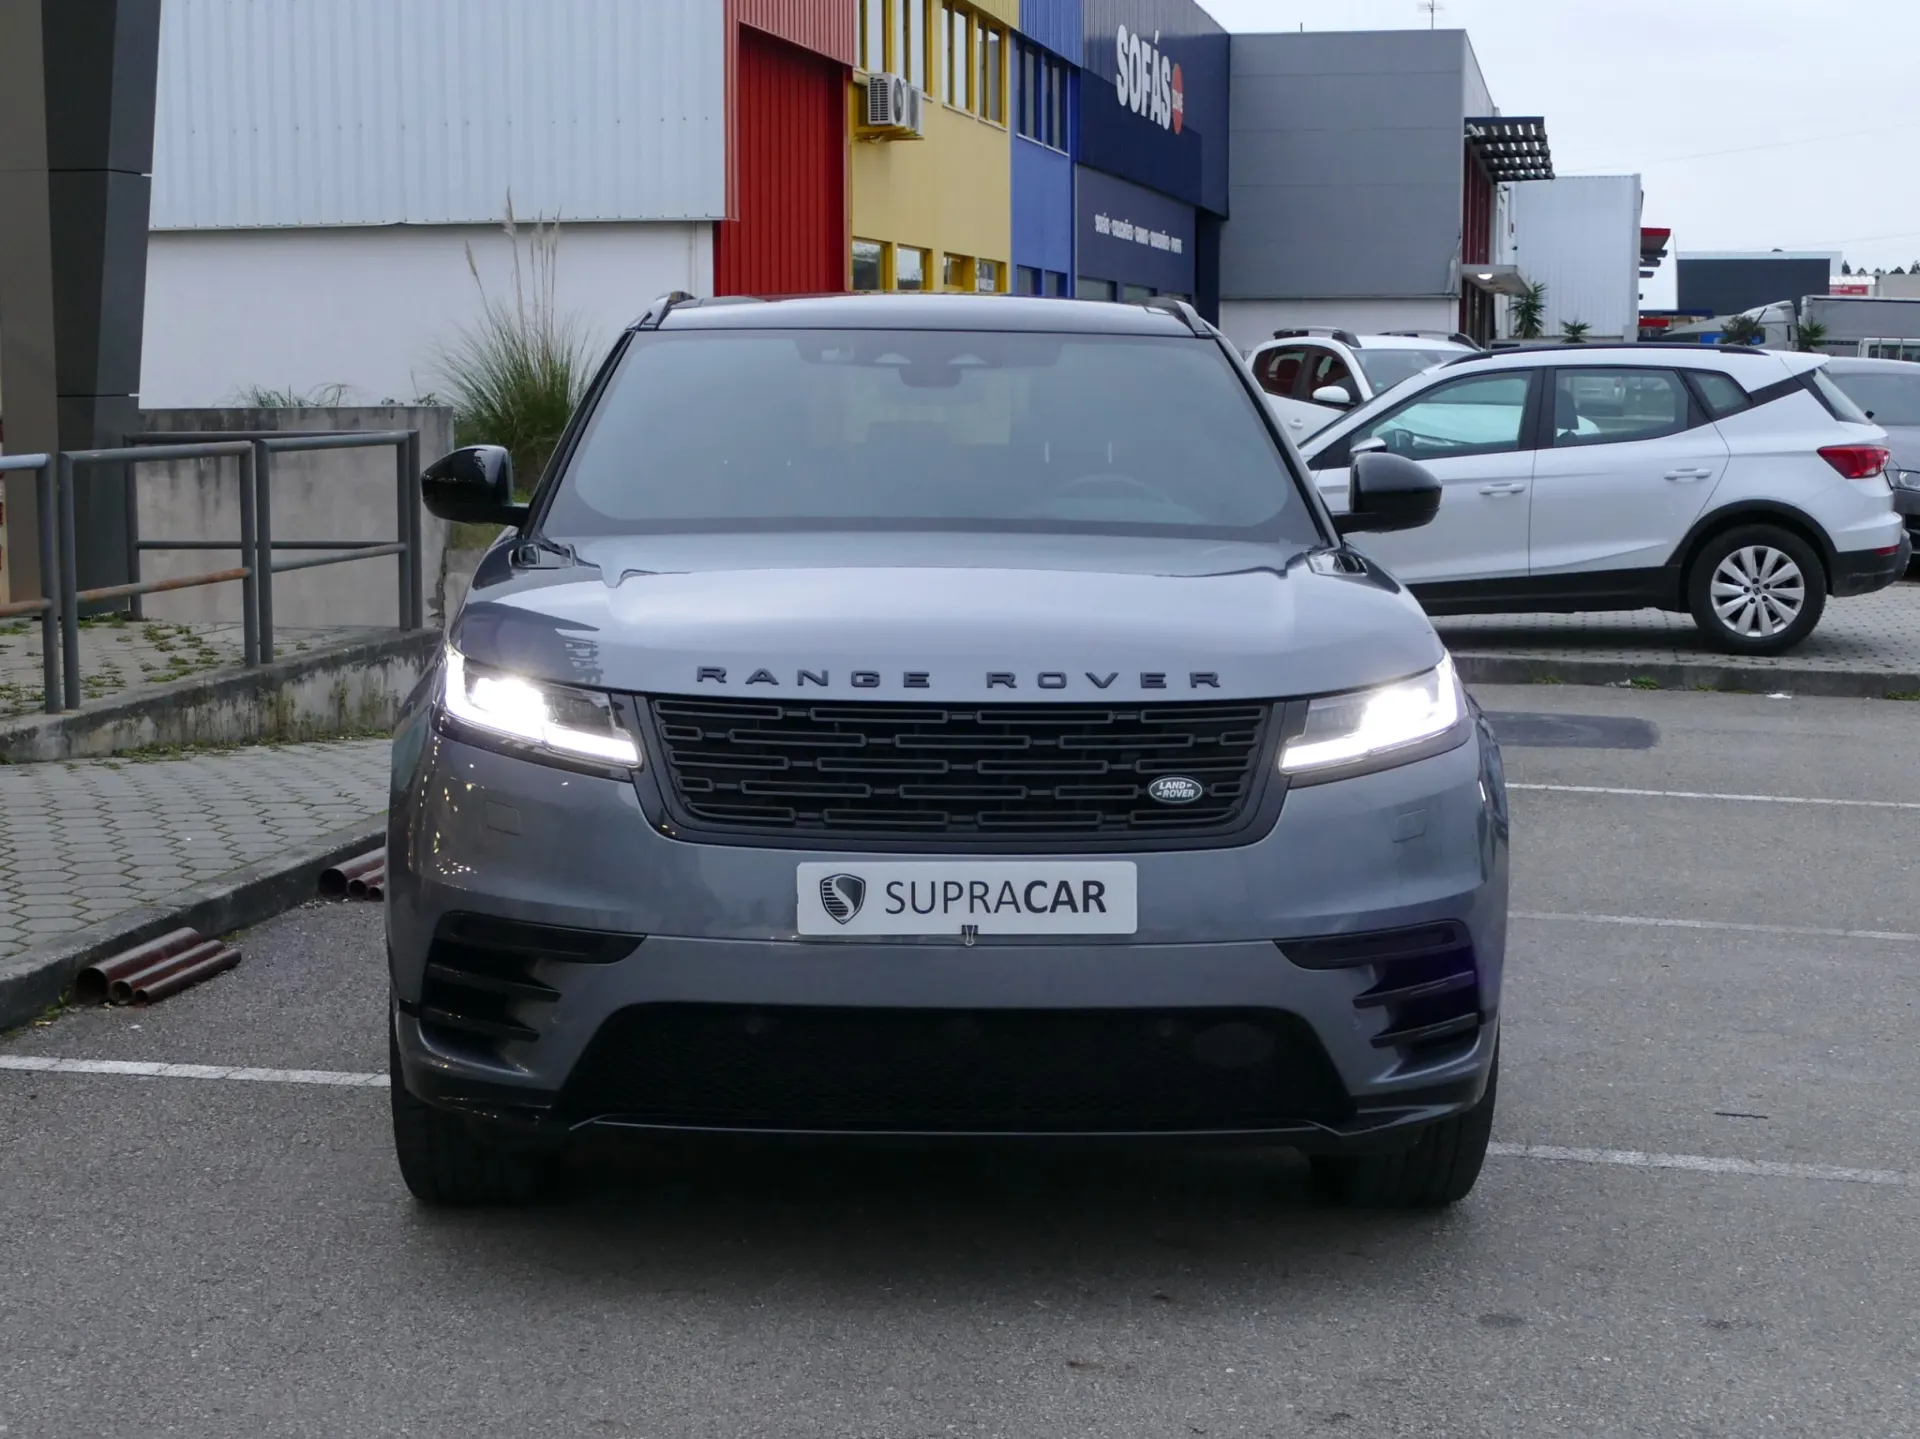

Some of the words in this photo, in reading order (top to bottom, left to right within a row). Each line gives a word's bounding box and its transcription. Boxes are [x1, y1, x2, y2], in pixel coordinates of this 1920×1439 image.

[1116, 24, 1171, 130] SOFÁS
[697, 665, 930, 688] RANGE
[986, 671, 1221, 689] ROVER
[1159, 781, 1186, 790] LAND
[1162, 789, 1195, 798] ROVER
[885, 880, 1107, 914] SUPRACAR
